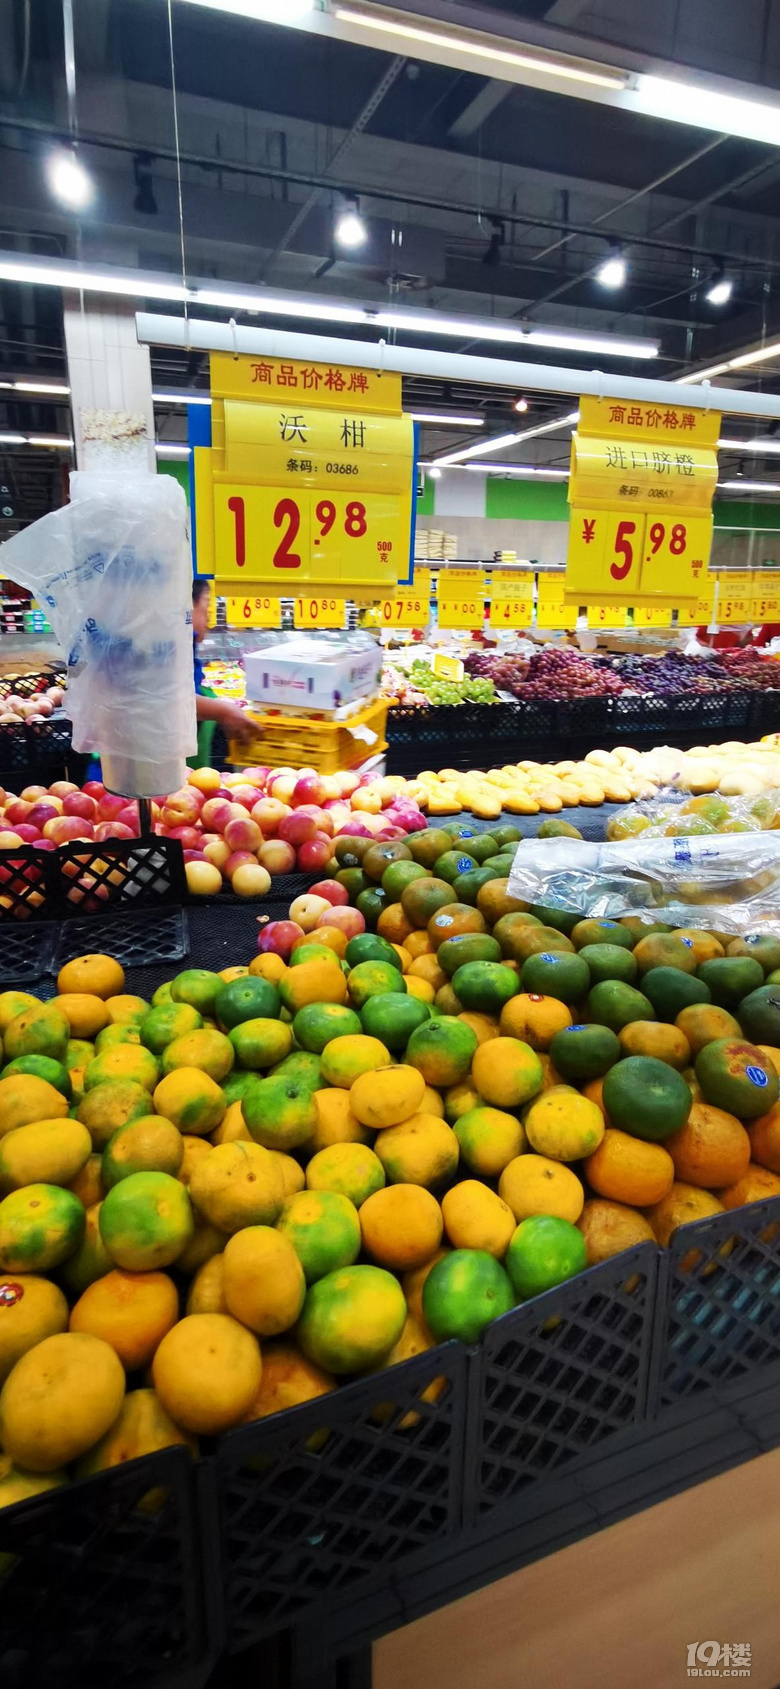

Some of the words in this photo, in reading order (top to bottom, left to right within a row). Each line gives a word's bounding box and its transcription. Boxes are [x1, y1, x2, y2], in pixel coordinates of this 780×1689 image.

[250, 362, 370, 394] 商品价格牌
[609, 405, 696, 431] 商品价格牌
[605, 446, 695, 477] 进口脐橙
[325, 462, 359, 475] 03686
[377, 541, 392, 552] 500
[379, 552, 389, 563] 克
[691, 559, 703, 569] 500
